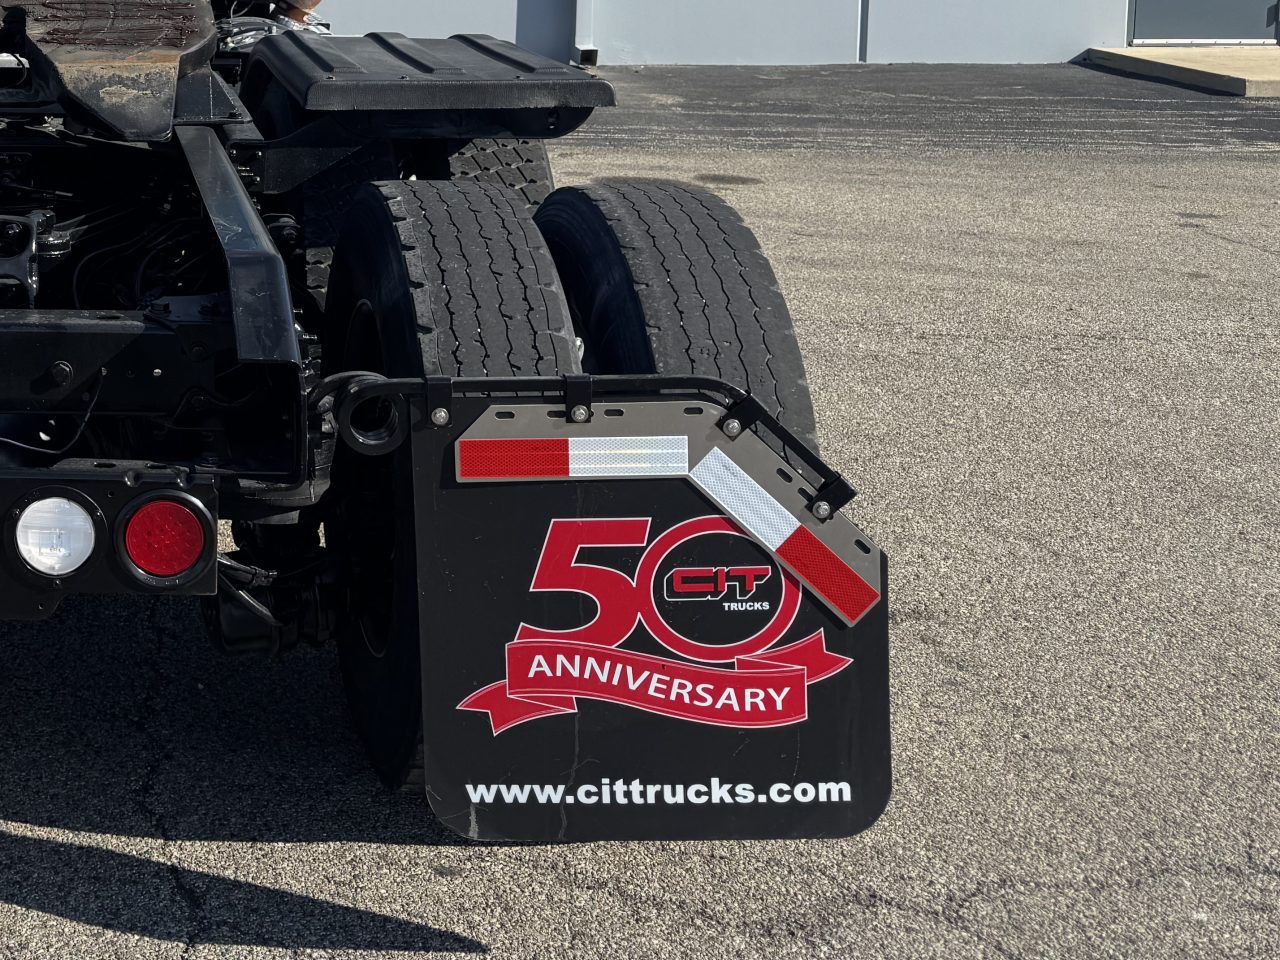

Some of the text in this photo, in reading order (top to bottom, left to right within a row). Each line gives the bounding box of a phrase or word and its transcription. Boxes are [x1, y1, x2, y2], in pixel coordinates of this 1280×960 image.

[671, 565, 772, 595] CIT
[723, 601, 770, 612] TRUCKS
[527, 653, 791, 712] ANNIVERSARY
[465, 777, 852, 805] www.cittrucks.com
